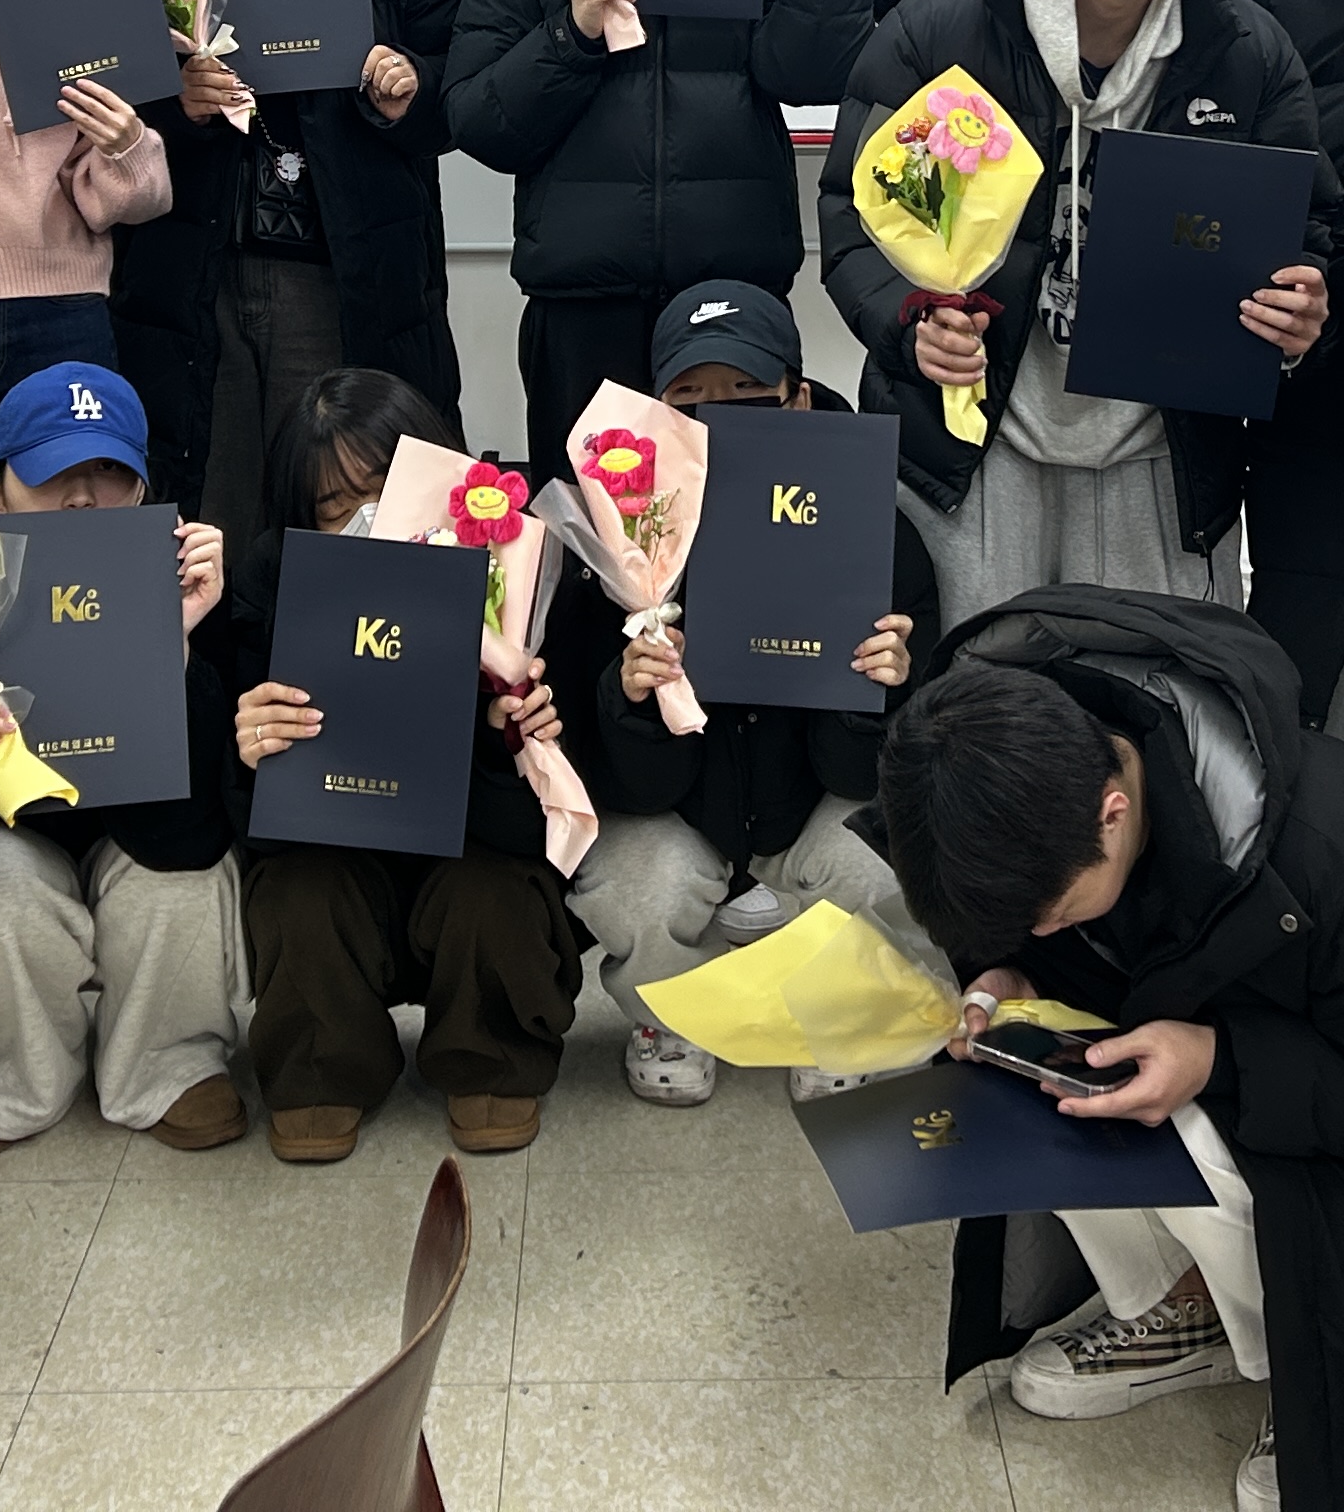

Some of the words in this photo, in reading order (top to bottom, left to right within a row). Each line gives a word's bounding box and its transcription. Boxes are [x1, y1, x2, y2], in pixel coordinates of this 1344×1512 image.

[1206, 112, 1237, 124] NEPA
[697, 301, 730, 315] NIKE
[68, 383, 103, 420] LA
